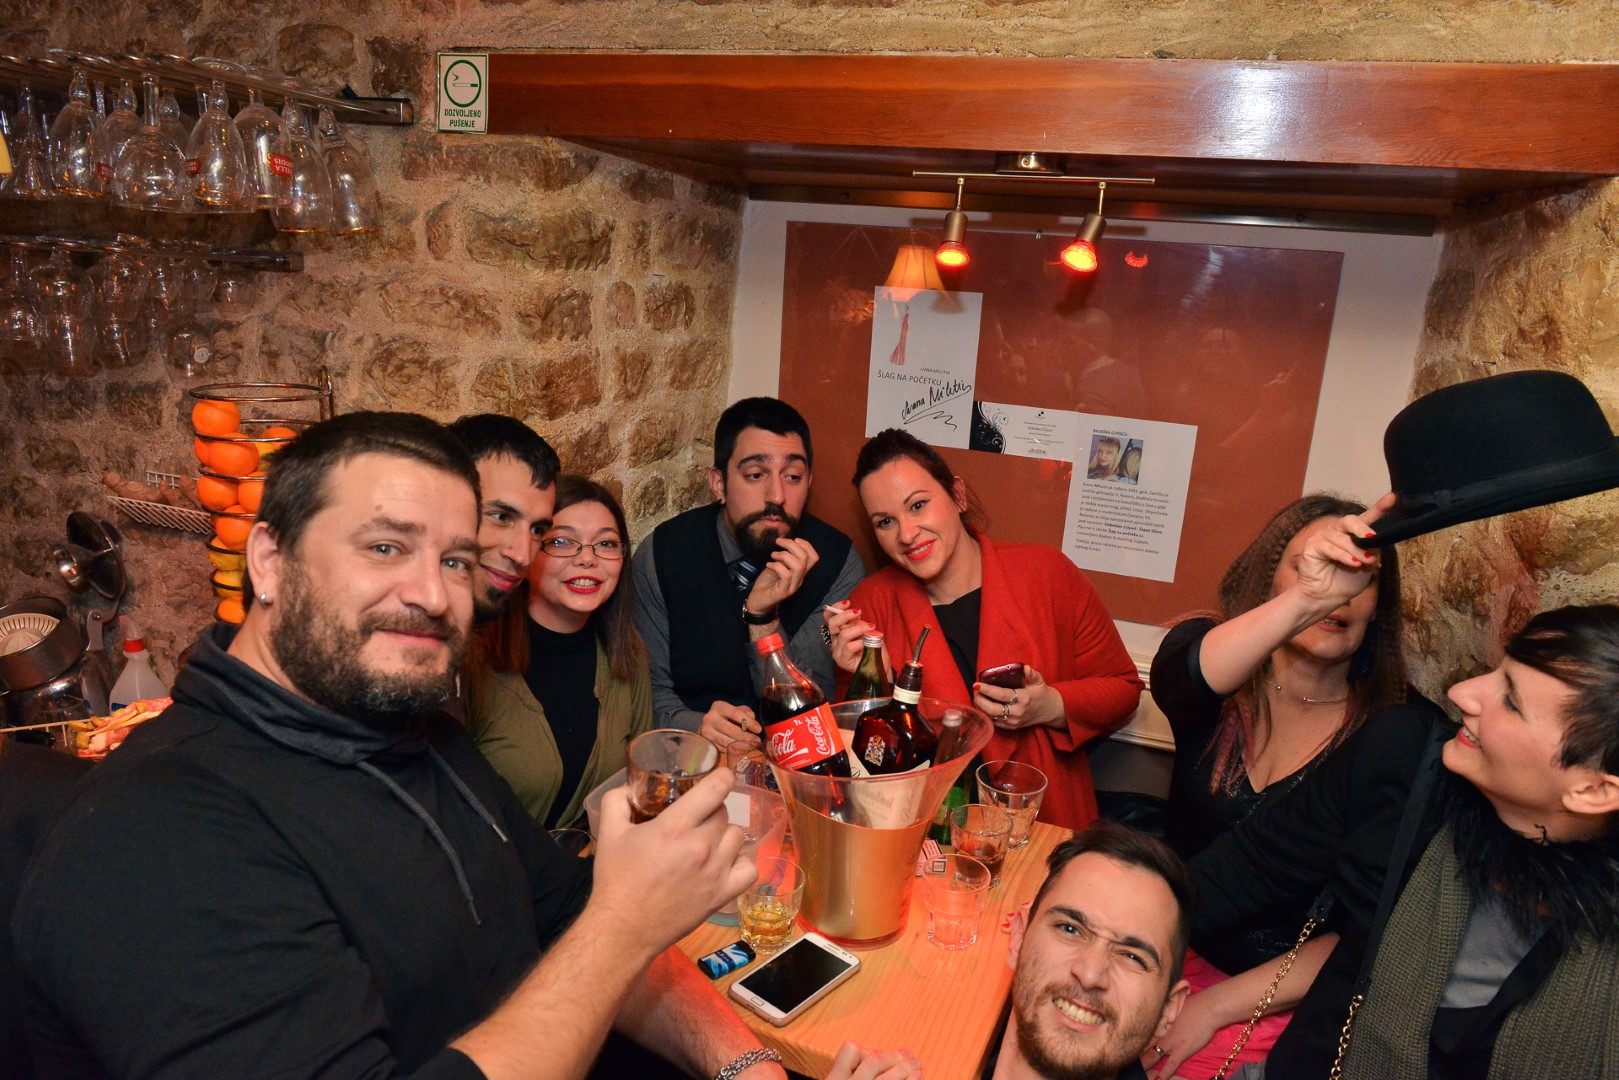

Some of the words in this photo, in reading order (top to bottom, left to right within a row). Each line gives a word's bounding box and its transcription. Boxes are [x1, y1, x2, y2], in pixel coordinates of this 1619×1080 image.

[445, 109, 481, 118] DOZVOLJENO
[449, 118, 475, 128] PUŠENJE
[877, 369, 896, 380] ŠLAG
[897, 373, 907, 381] NA
[909, 375, 942, 386] POČETKU
[771, 728, 797, 757] Cola
